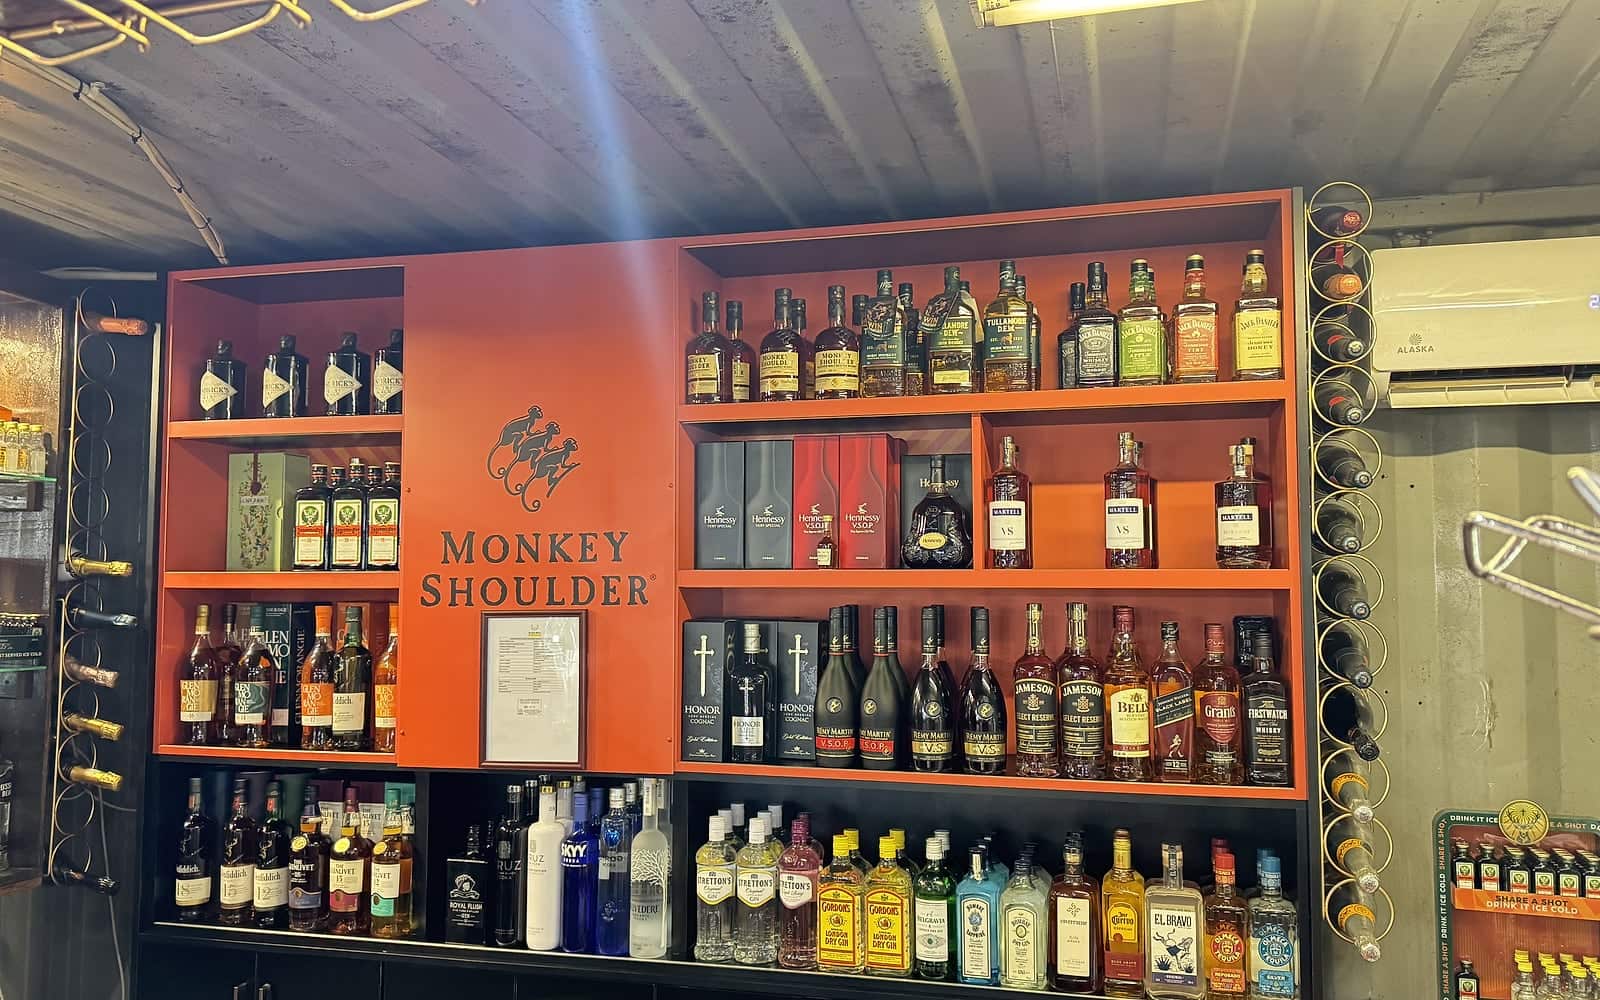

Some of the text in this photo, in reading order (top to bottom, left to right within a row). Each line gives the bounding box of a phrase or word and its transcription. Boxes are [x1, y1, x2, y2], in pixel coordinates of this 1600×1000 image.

[945, 320, 969, 330] LAMORE
[987, 317, 1026, 327] TULLAMORE
[1397, 345, 1435, 354] ALASKA
[920, 478, 960, 489] Hessy
[704, 515, 736, 525] Hennessy
[752, 515, 785, 525] Hennessy
[799, 514, 824, 522] Henne
[845, 513, 880, 522] Hennessy
[1000, 527, 1014, 535] VS
[1116, 525, 1130, 534] VS
[441, 531, 629, 564] MONKEY
[420, 573, 649, 607] SHOULDER
[266, 630, 289, 644] LEN
[1015, 683, 1054, 696] JAMESON
[1062, 684, 1102, 697] JAMESON
[780, 703, 815, 713] HONOR
[1174, 698, 1192, 707] LABEL
[685, 705, 721, 715] HONOR
[1205, 705, 1236, 719] Grant's
[1248, 709, 1288, 720] FIRSTWATCH
[734, 720, 761, 728] HONOR
[831, 728, 853, 737] MARTIN
[866, 730, 891, 739] MARTIN
[1438, 819, 1448, 838] SHOT
[1564, 822, 1586, 830] SHOT
[561, 843, 587, 858] SKYY
[1438, 847, 1446, 870] SHARE
[698, 876, 732, 885] TRETTON'S
[176, 881, 191, 896] 18
[223, 884, 237, 898] 15
[257, 885, 272, 900] 12
[450, 902, 466, 910] ROYAL
[822, 901, 851, 913] GORDON'S
[1495, 896, 1568, 907] SHARE A SHOT
[869, 904, 899, 916] GORDON'S
[1486, 900, 1578, 915] DRINK IT ICE COLD
[1111, 916, 1134, 926] Cuervo
[1154, 913, 1192, 927] EL BRAVO
[825, 930, 848, 938] LONDON
[873, 933, 897, 942] LONDON
[1214, 934, 1239, 945] OLMECA
[825, 937, 849, 947] DRY GIN
[872, 940, 897, 950] DRY GIN
[1262, 935, 1288, 947] OLMECA
[1215, 951, 1241, 963] TEQUILA
[1441, 942, 1449, 961] SHOT
[1263, 953, 1290, 967] TEQUILA
[1442, 970, 1450, 994] SHARE
